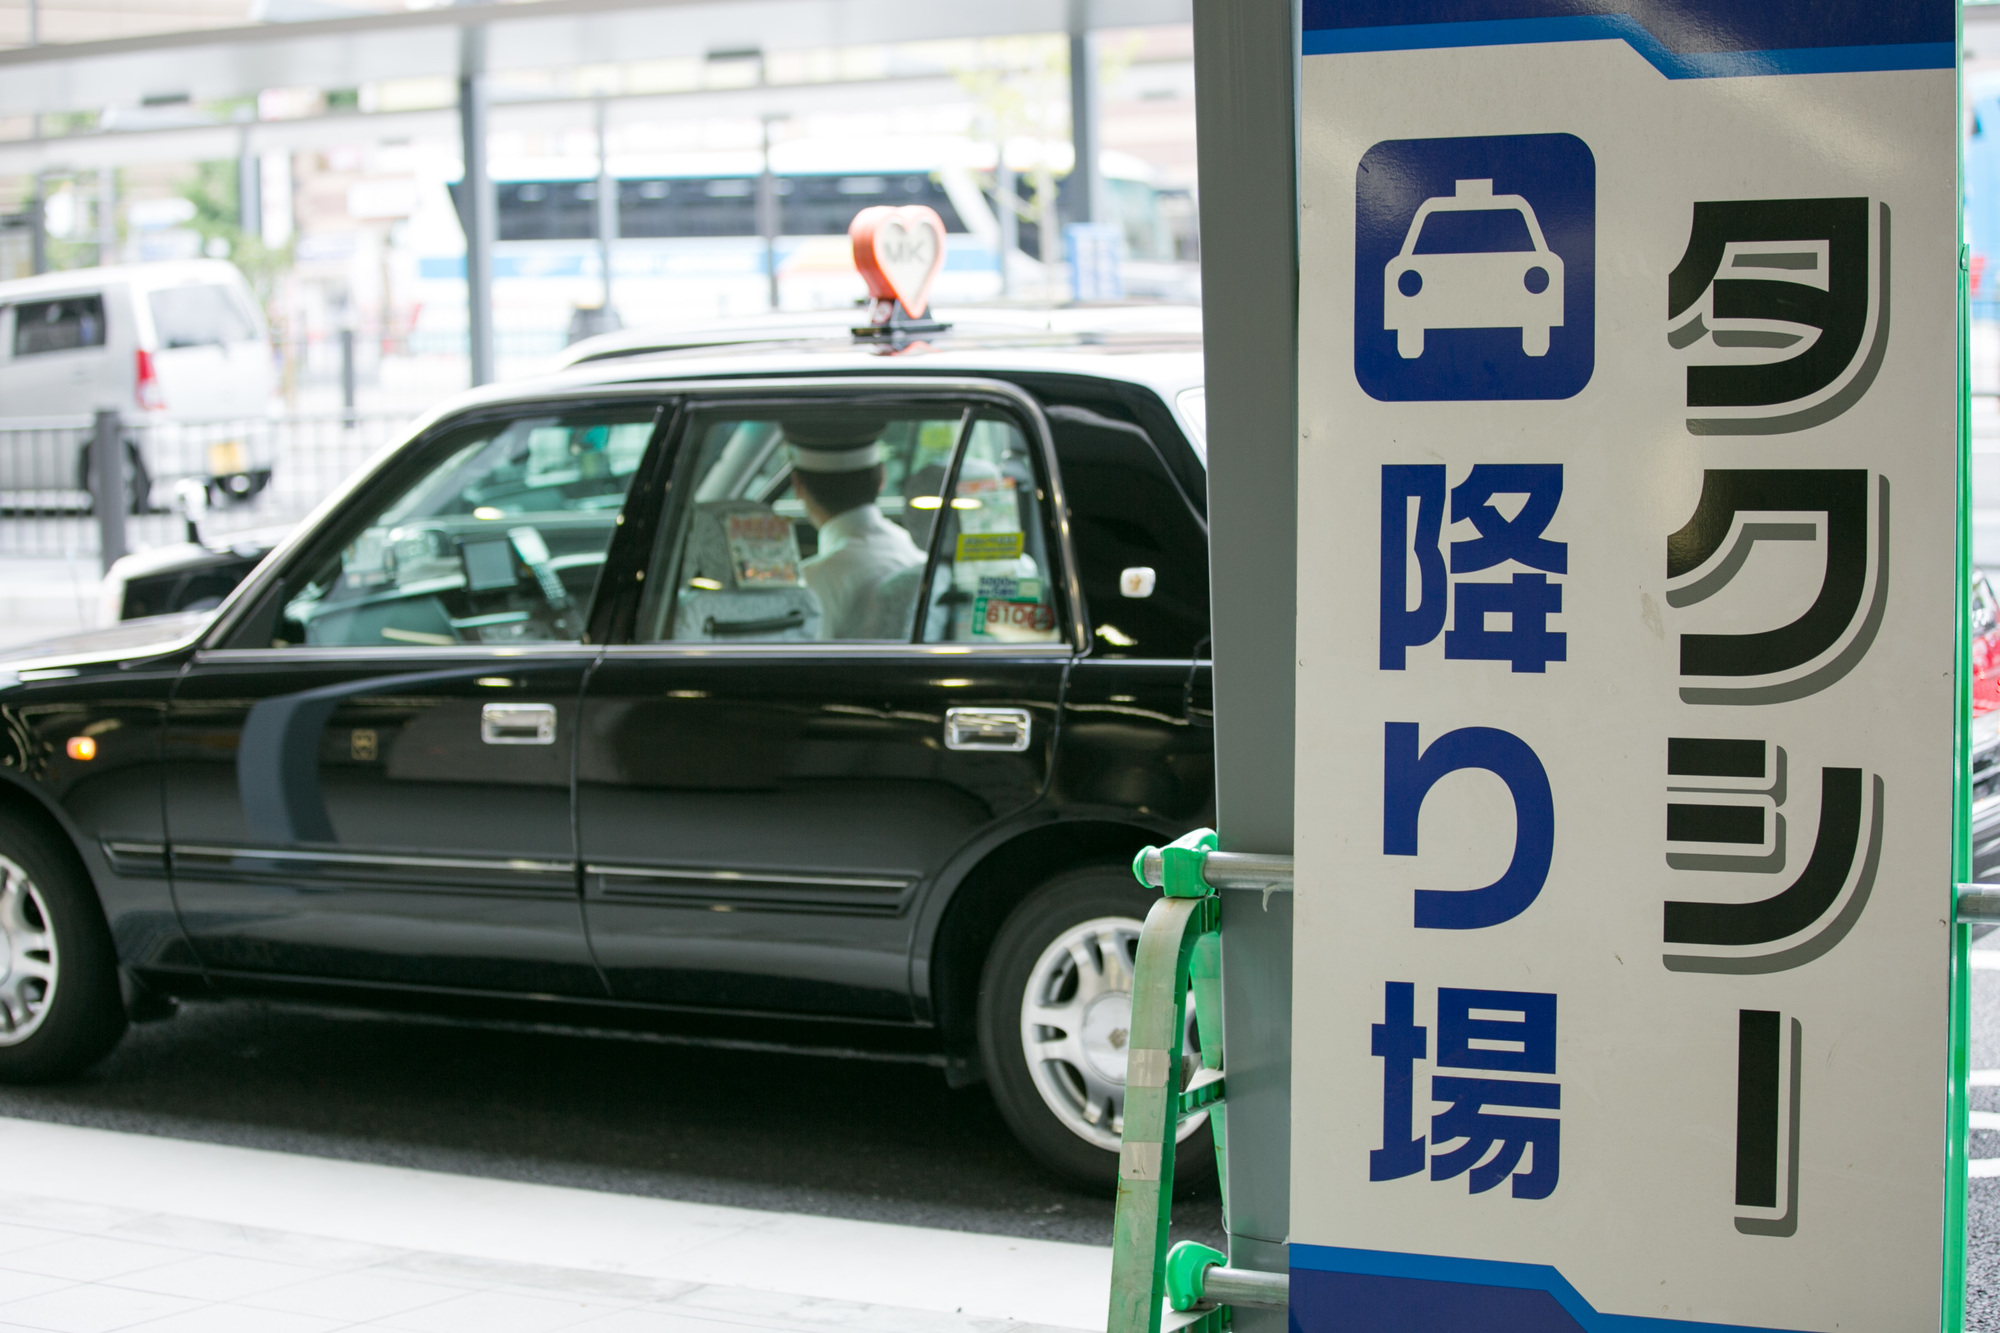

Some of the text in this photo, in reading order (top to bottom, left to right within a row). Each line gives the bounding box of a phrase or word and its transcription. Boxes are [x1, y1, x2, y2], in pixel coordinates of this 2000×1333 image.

[884, 241, 925, 263] MK
[1370, 463, 1568, 1200] 降り場
[1663, 198, 1890, 1236] タクシー
